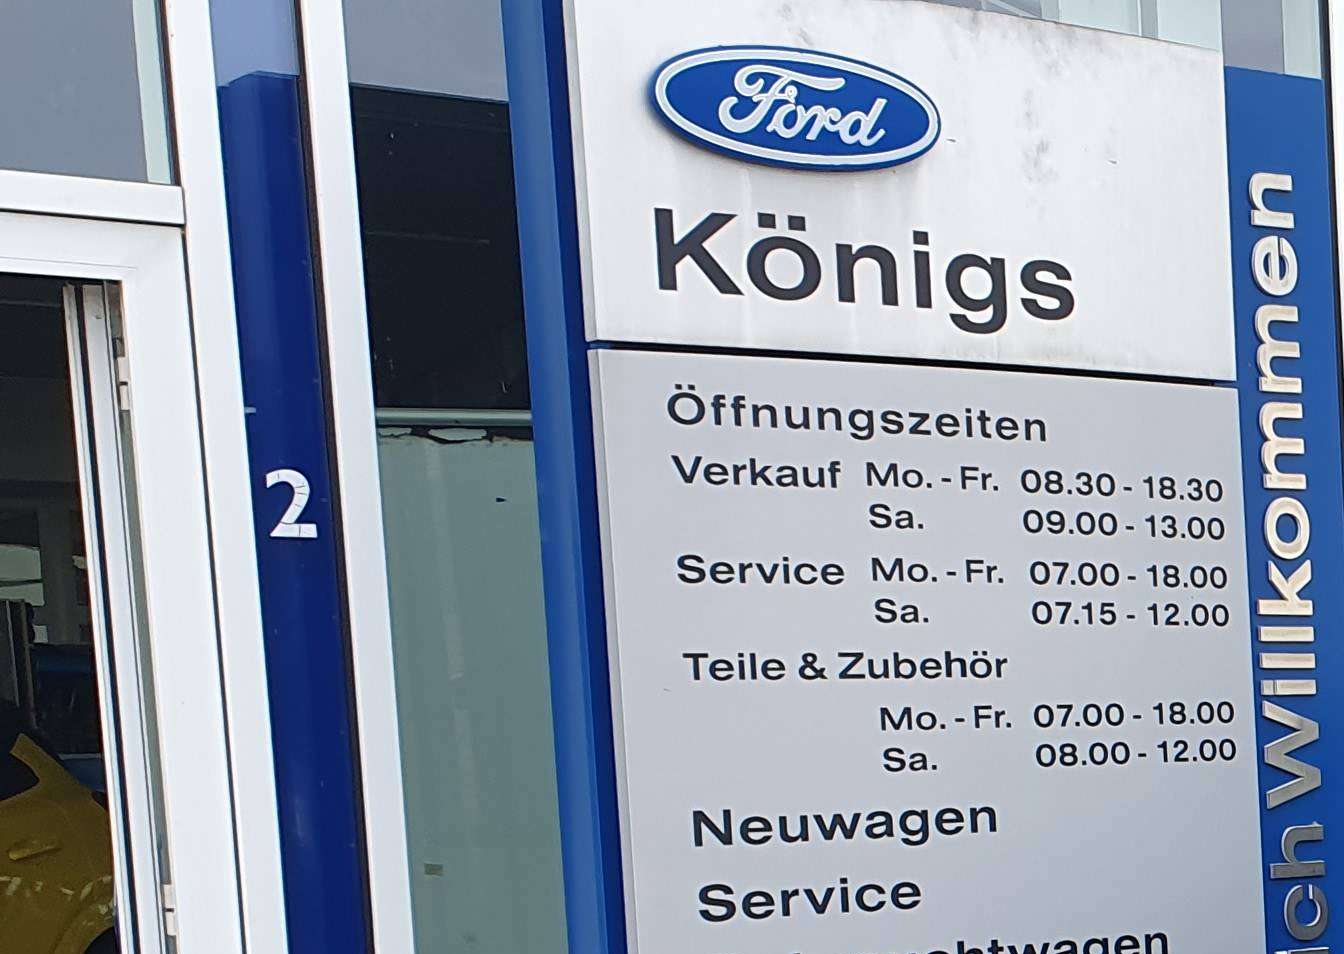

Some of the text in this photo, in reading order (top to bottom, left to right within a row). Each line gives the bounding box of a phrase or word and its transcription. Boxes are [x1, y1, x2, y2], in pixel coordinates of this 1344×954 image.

[717, 64, 888, 147] Ford
[654, 207, 1075, 335] Königs
[667, 383, 1047, 442] Öffnungszeiten
[670, 454, 841, 489] Verkauf
[866, 461, 933, 489] Mo.
[960, 465, 999, 492] Fr.
[1020, 469, 1116, 497] 08.30
[1142, 475, 1224, 503] 18.30
[1247, 170, 1323, 811] Willkommen
[266, 469, 318, 539] 2
[869, 503, 924, 530] Sa.
[1022, 509, 1118, 537] 09.00
[1144, 514, 1225, 541] 13.00
[677, 554, 845, 586] Service
[871, 557, 938, 583] Mo.
[965, 559, 1004, 584] Fr.
[1029, 560, 1120, 587] 07.00
[1146, 564, 1228, 590] 18.00
[874, 598, 929, 624] Sa.
[1031, 600, 1117, 626] 07.15
[1147, 602, 1230, 627] 12.00
[682, 650, 1008, 682] Teile & Zubehör
[879, 706, 946, 731] Mo.
[973, 704, 1012, 729] Fr.
[1033, 702, 1125, 729] 07.00
[1152, 700, 1235, 725] 18.00
[883, 747, 938, 773] Sa.
[1035, 741, 1131, 768] 08.00
[1156, 738, 1237, 763] 12.00
[692, 806, 997, 847] Neuwagen
[698, 877, 922, 923] Service
